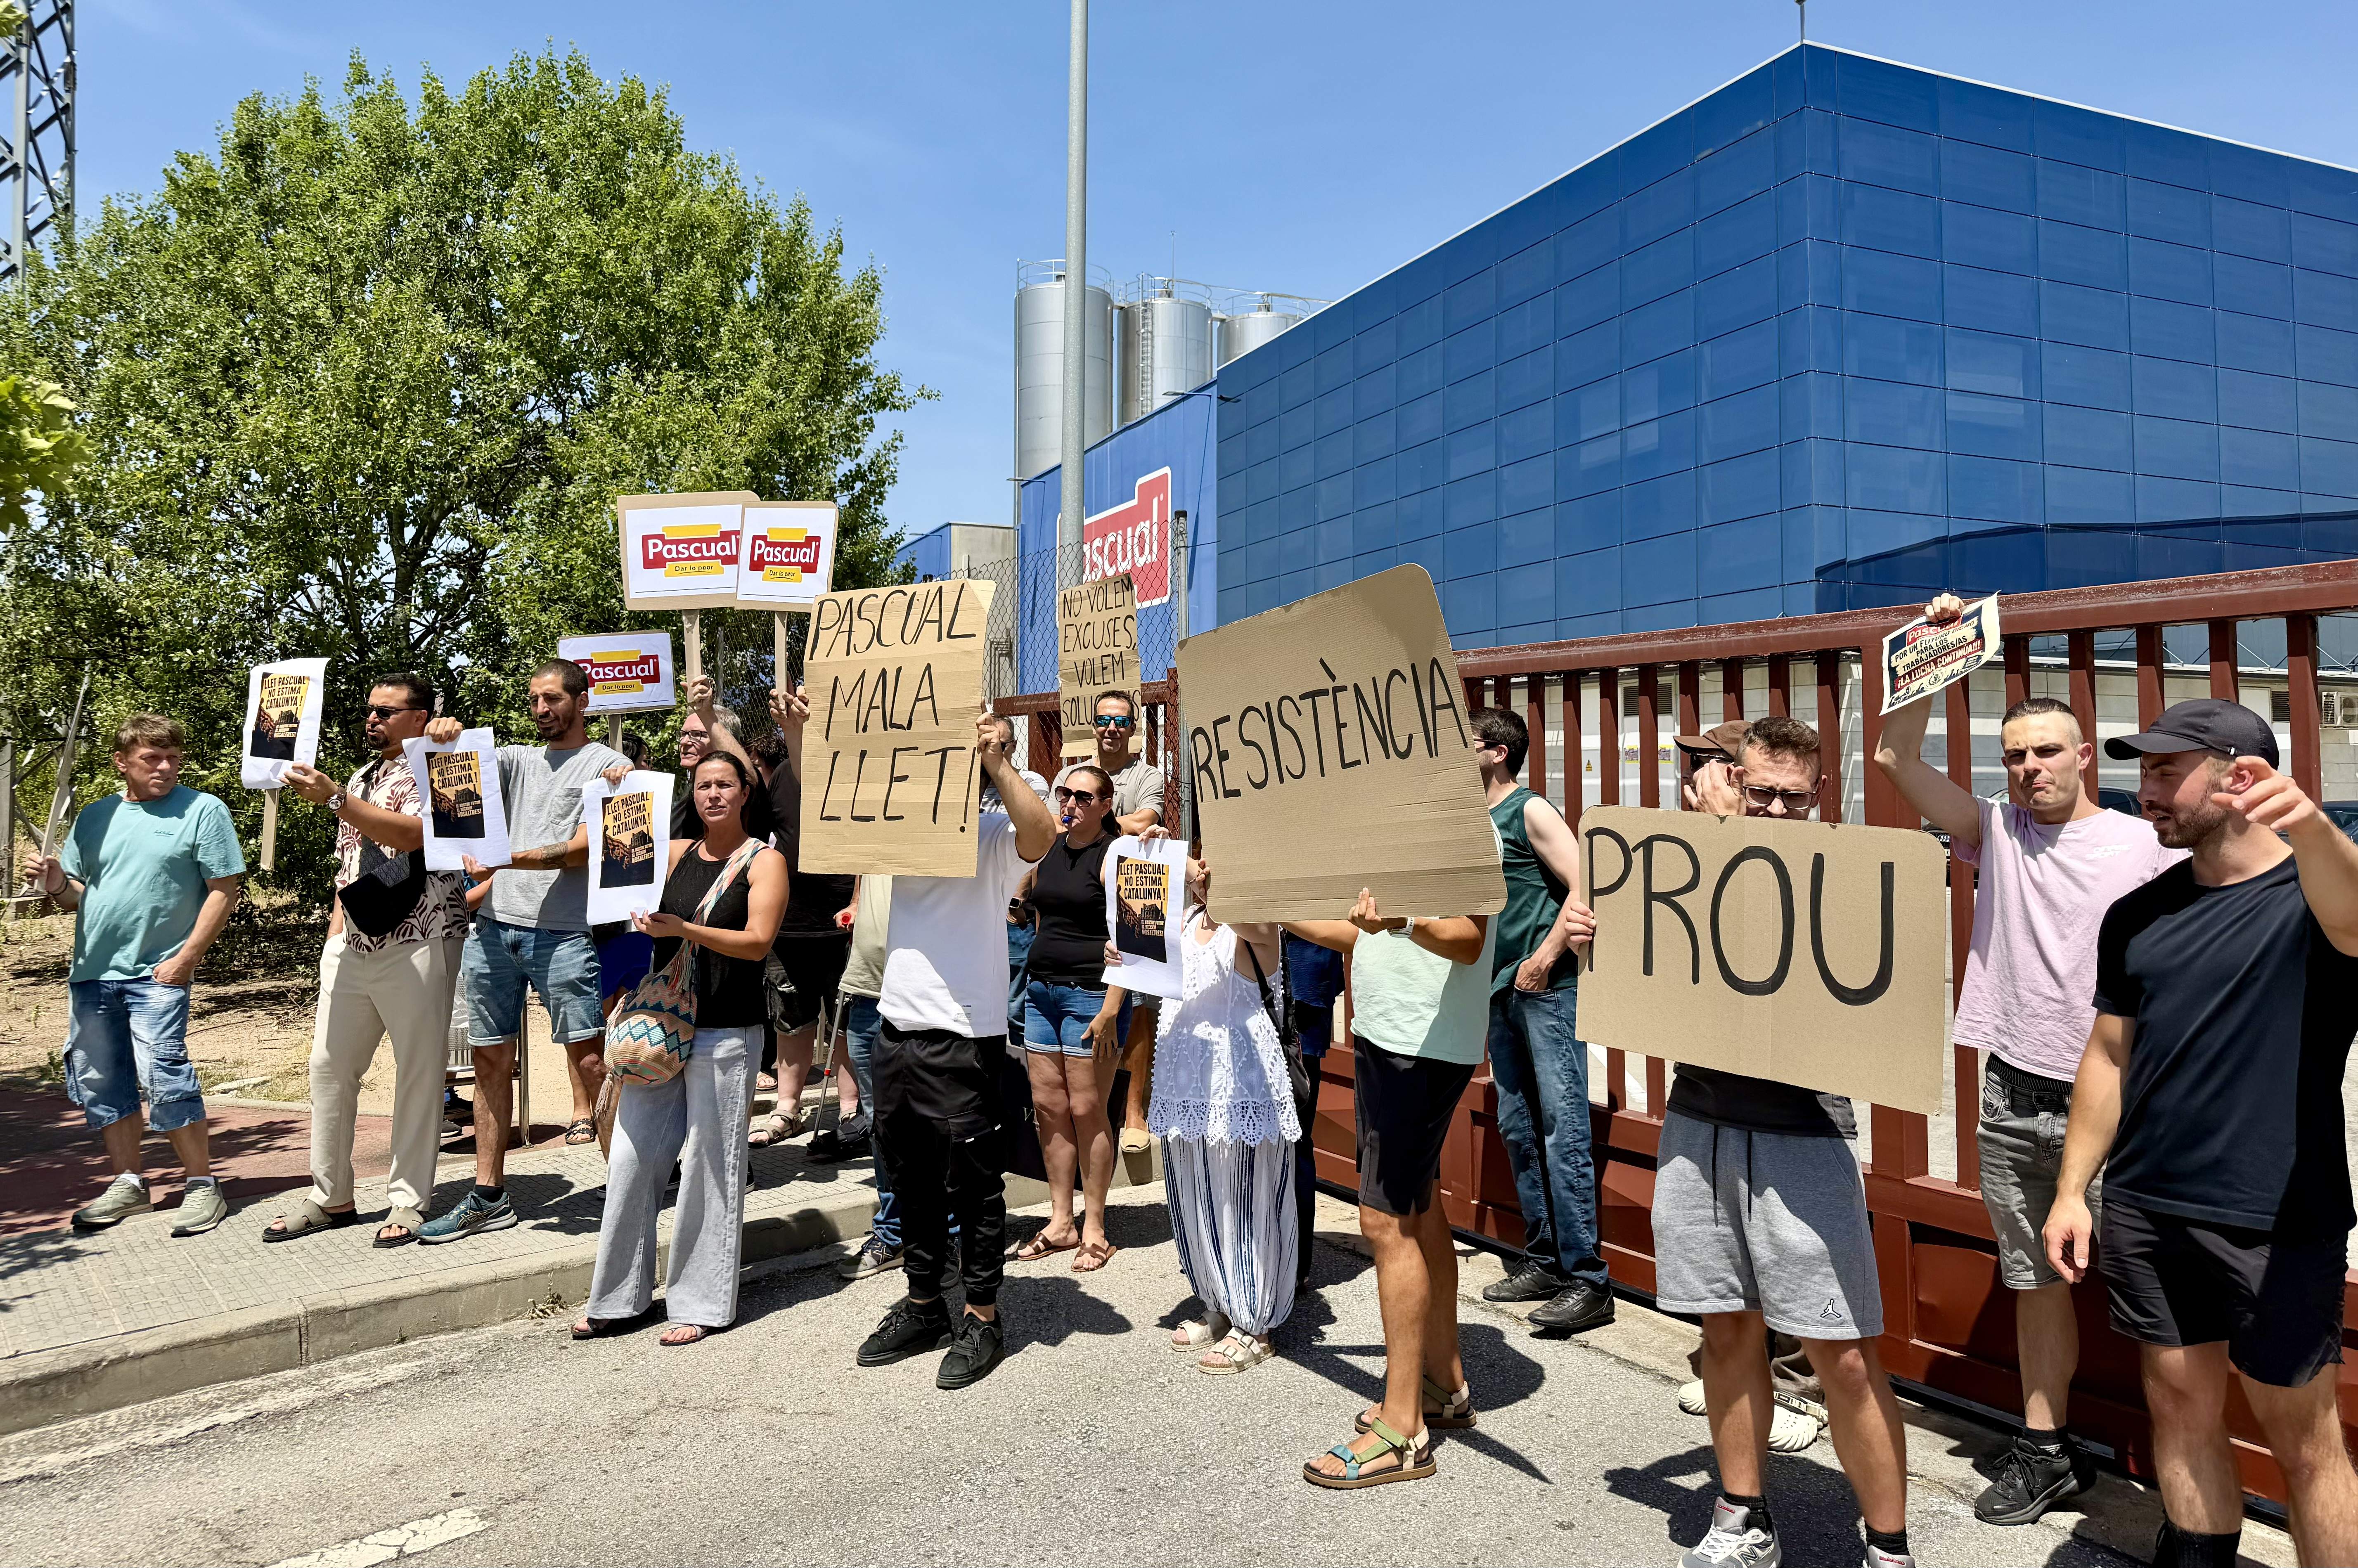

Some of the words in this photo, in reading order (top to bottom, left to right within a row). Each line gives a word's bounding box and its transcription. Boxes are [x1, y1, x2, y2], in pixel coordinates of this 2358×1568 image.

[648, 535, 737, 559] Pascual
[754, 540, 816, 563] Pascual
[1063, 591, 1083, 620] NO
[1088, 575, 1134, 613] VOLEM
[809, 583, 976, 661] PASCUAL
[1063, 614, 1137, 653] EXCUSES,
[1895, 649, 1907, 662] POR
[1909, 643, 1918, 654] UN
[1920, 631, 1950, 648] FUTURO
[1902, 636, 1967, 672] TRABAJADORES/AS
[1916, 644, 1934, 657] PARA
[1936, 638, 1948, 647] LOS
[264, 678, 277, 689] LLET
[278, 675, 306, 687] PASCUAL
[1074, 651, 1124, 688] VOLEM
[1898, 674, 1909, 689] ¡LA
[1912, 662, 1936, 680] LUCHA
[268, 689, 276, 698] NO
[277, 686, 301, 696] ESTIMA
[826, 662, 939, 742] MALA
[1063, 690, 1141, 727] SOLUS
[1190, 657, 1468, 802] RESISTÈNCIA
[431, 757, 444, 770] LLET
[444, 752, 475, 766] PASCUAL
[437, 769, 445, 778] NO
[447, 763, 473, 776] ESTIMA
[820, 746, 977, 832] LLET!
[607, 800, 620, 816] LLET
[621, 791, 650, 809] PASCUAL
[613, 812, 621, 824] NO
[623, 803, 646, 818] ESTIMA
[1120, 863, 1134, 875] LLET
[1135, 863, 1166, 875] PASCUAL
[1125, 876, 1133, 887] NO
[1135, 876, 1162, 887] ESTIMA
[1584, 827, 1894, 1006] PROU
